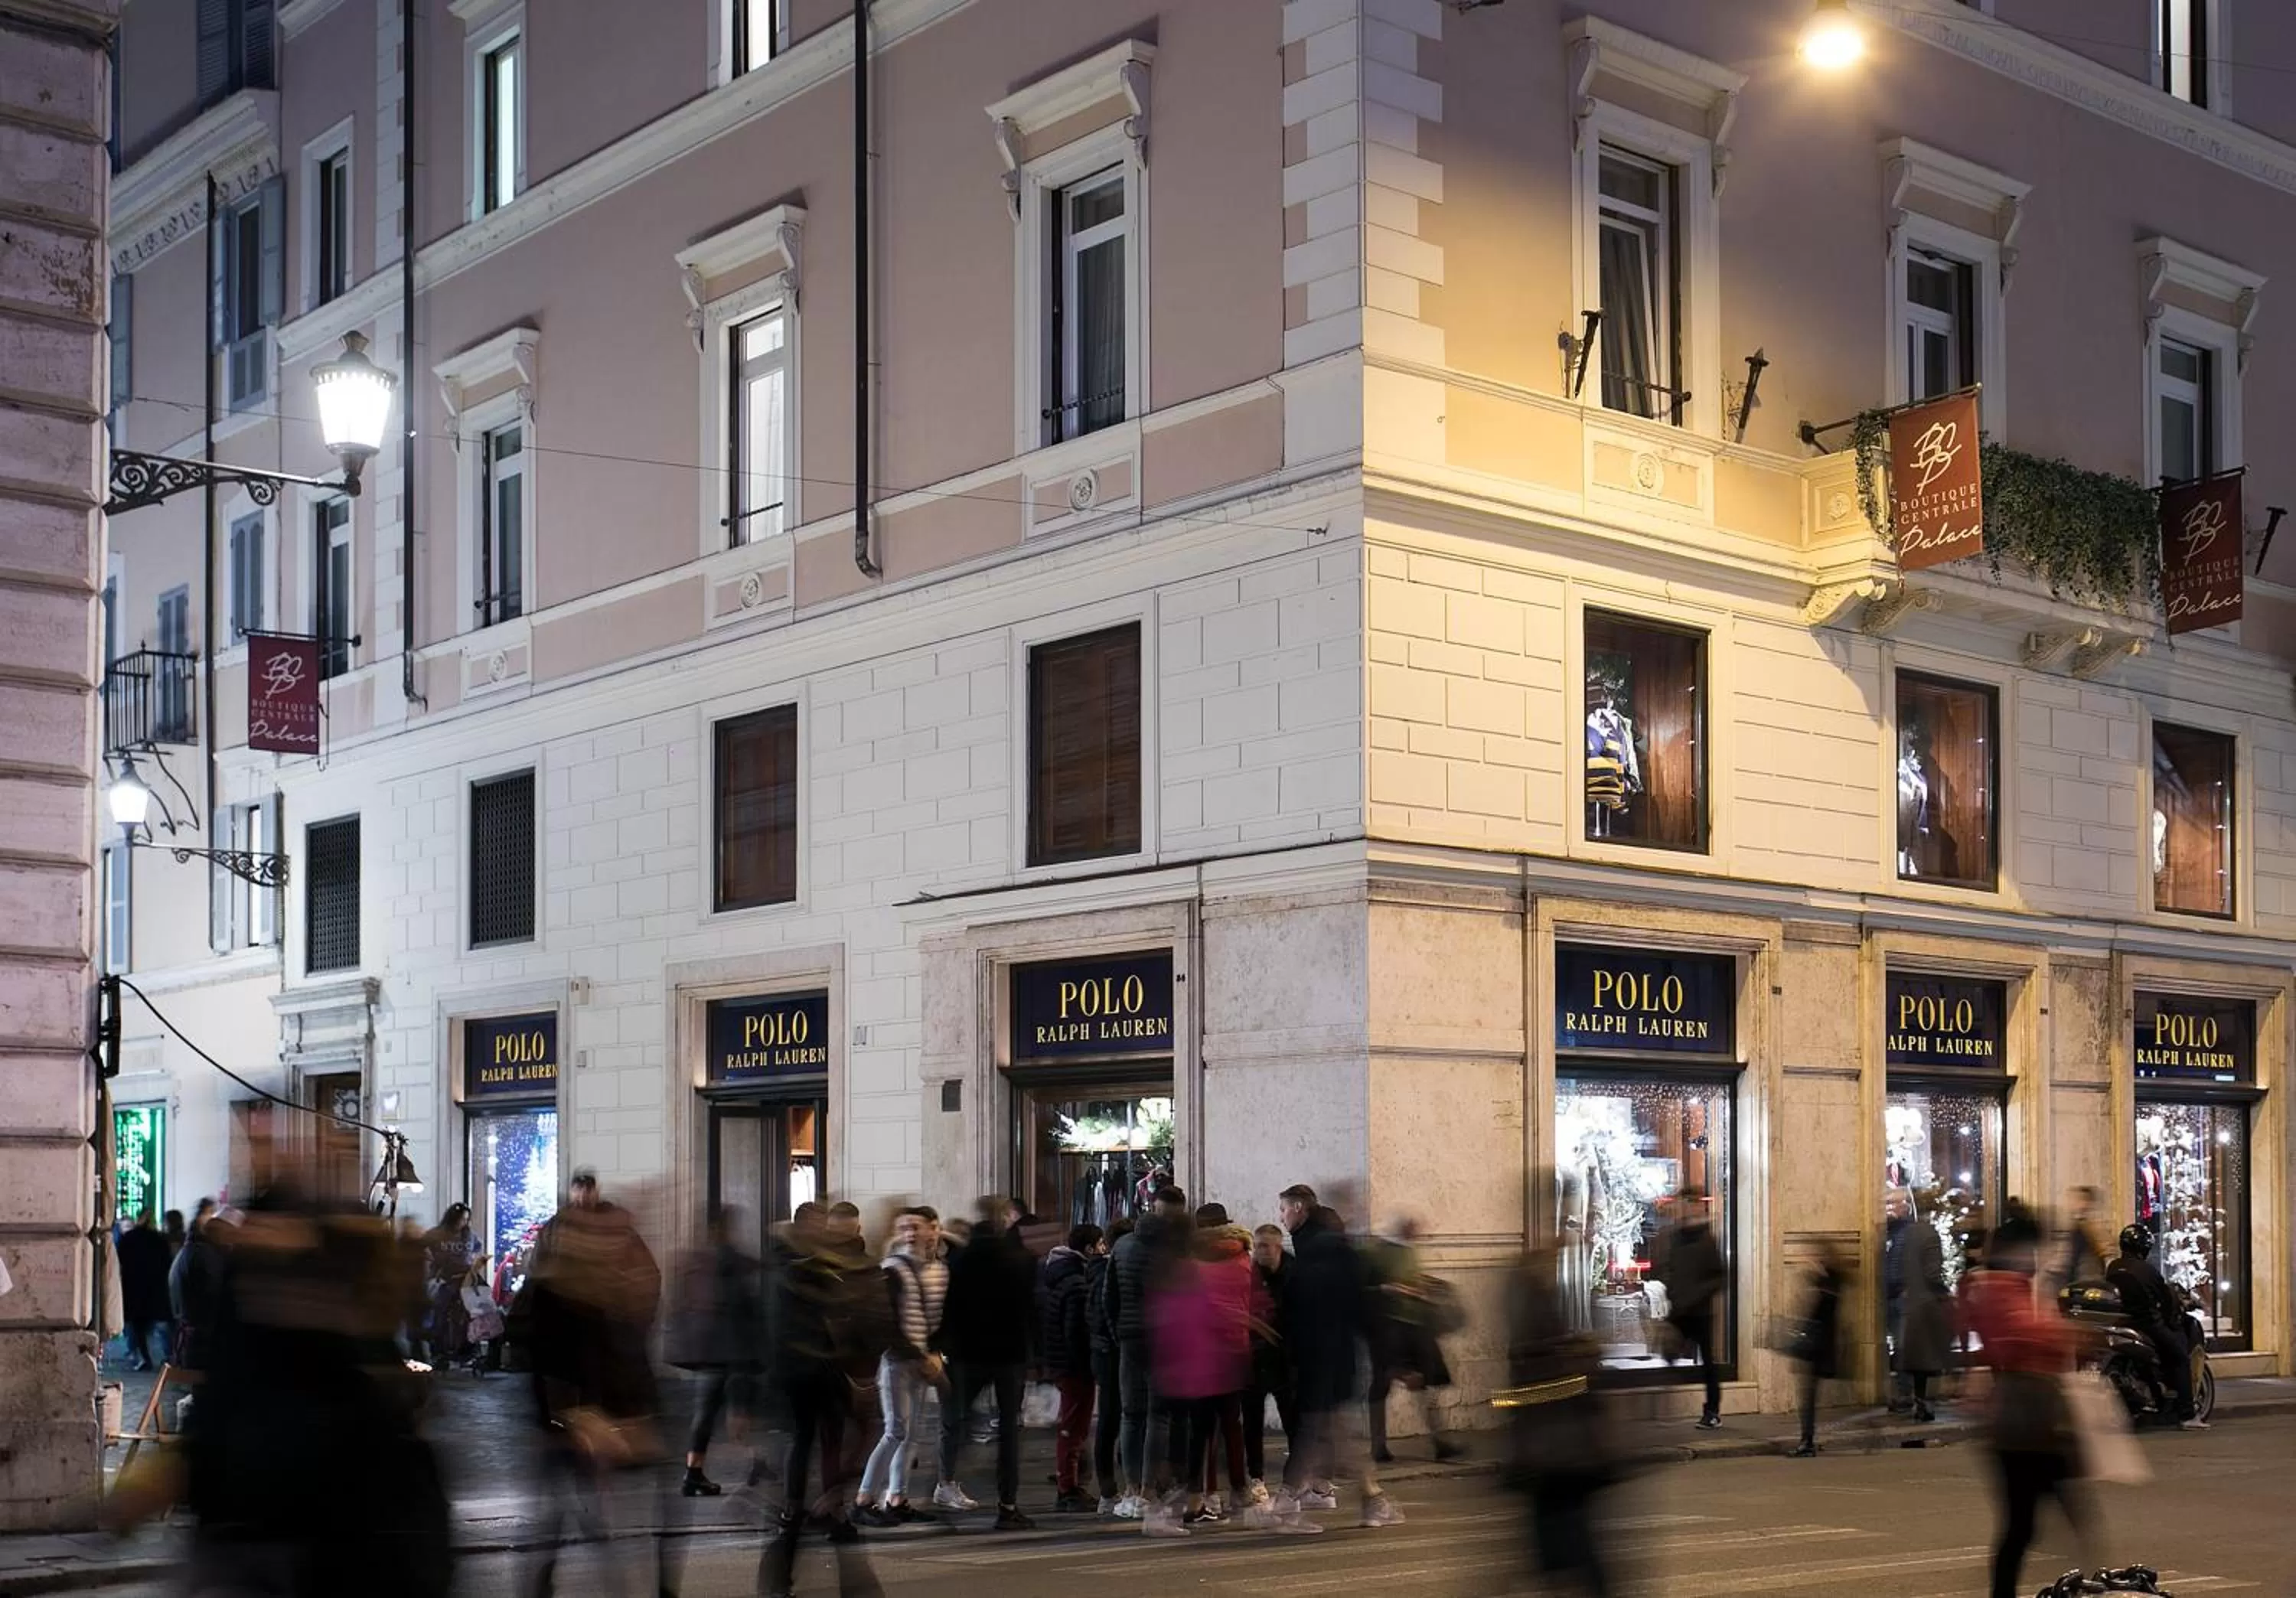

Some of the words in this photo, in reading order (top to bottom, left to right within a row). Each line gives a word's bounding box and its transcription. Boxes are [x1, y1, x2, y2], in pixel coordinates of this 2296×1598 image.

[1900, 483, 1977, 512] BOUTIQUE
[1901, 497, 1977, 524] CENTRALE
[1900, 522, 1981, 557] Palace
[2169, 556, 2239, 581] BOUTIQUE
[2169, 569, 2239, 592] CENTRALE
[2167, 591, 2242, 619] Palace
[252, 698, 315, 713] BOUTIQUE
[249, 719, 318, 742] Palace
[1059, 974, 1144, 1019] POLO
[1593, 970, 1683, 1014] POLO
[1566, 1013, 1626, 1033] RALPH
[1638, 1017, 1708, 1039] LAUREN
[1899, 995, 1972, 1033] POLO
[744, 1010, 807, 1048] POLO
[1036, 1022, 1090, 1044] RALPH
[1101, 1017, 1168, 1039] LAUREN
[2155, 1013, 2217, 1049] POLO
[495, 1031, 545, 1064] POLO
[727, 1051, 768, 1069] RALPH
[775, 1047, 826, 1065] LAUREN
[1887, 1034, 1927, 1052] ALPH
[1936, 1037, 1992, 1055] LAUREN
[2137, 1048, 2179, 1066] RALPH
[2186, 1052, 2234, 1069] LAUREN
[481, 1067, 514, 1082] RALPH
[519, 1064, 557, 1080] LAUREN
